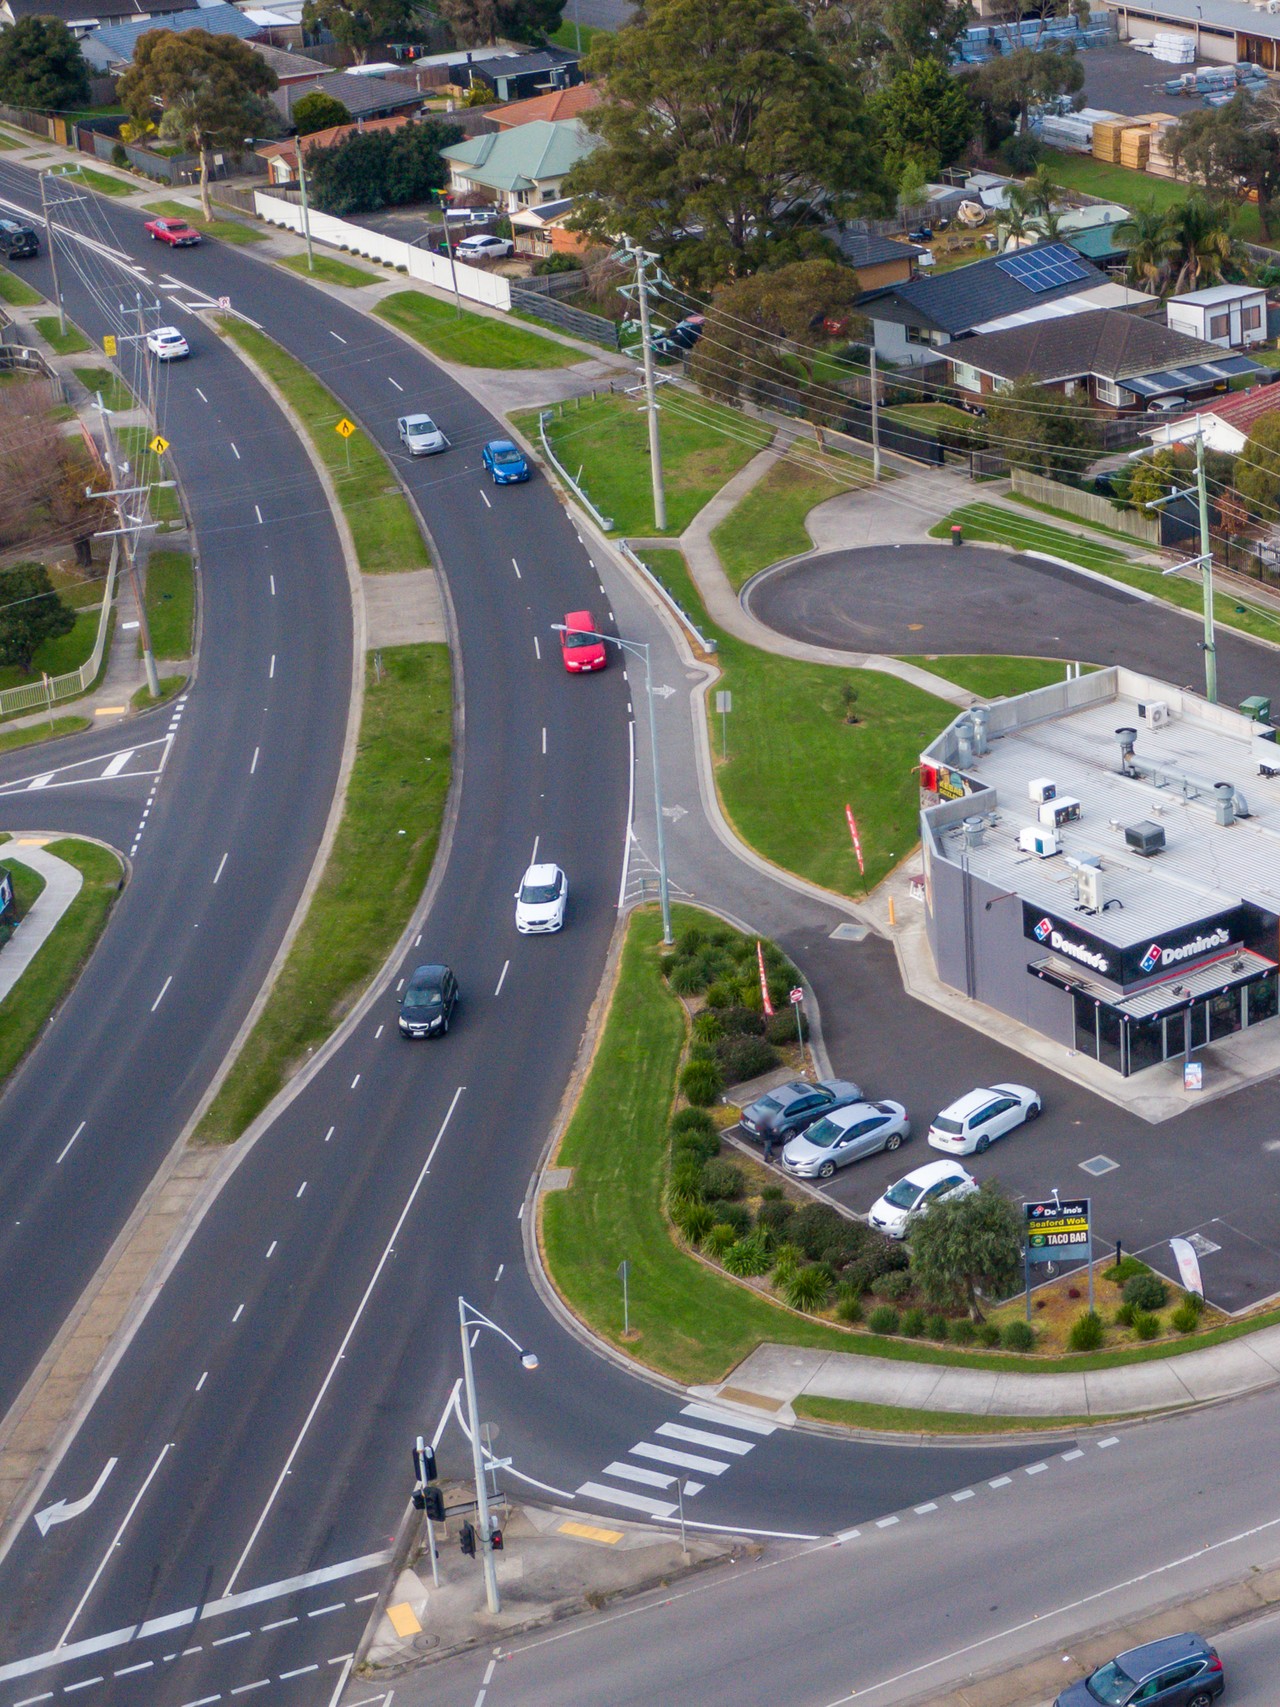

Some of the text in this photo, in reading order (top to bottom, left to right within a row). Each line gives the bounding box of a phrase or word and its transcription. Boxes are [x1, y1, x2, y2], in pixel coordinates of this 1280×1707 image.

[1051, 931, 1109, 973] Domino's
[1161, 928, 1231, 965] Domino's
[1044, 1206, 1082, 1216] Doino's
[1029, 1217, 1086, 1228] Seaford Wok
[1047, 1233, 1069, 1244] TACO
[1070, 1232, 1086, 1243] BAR
